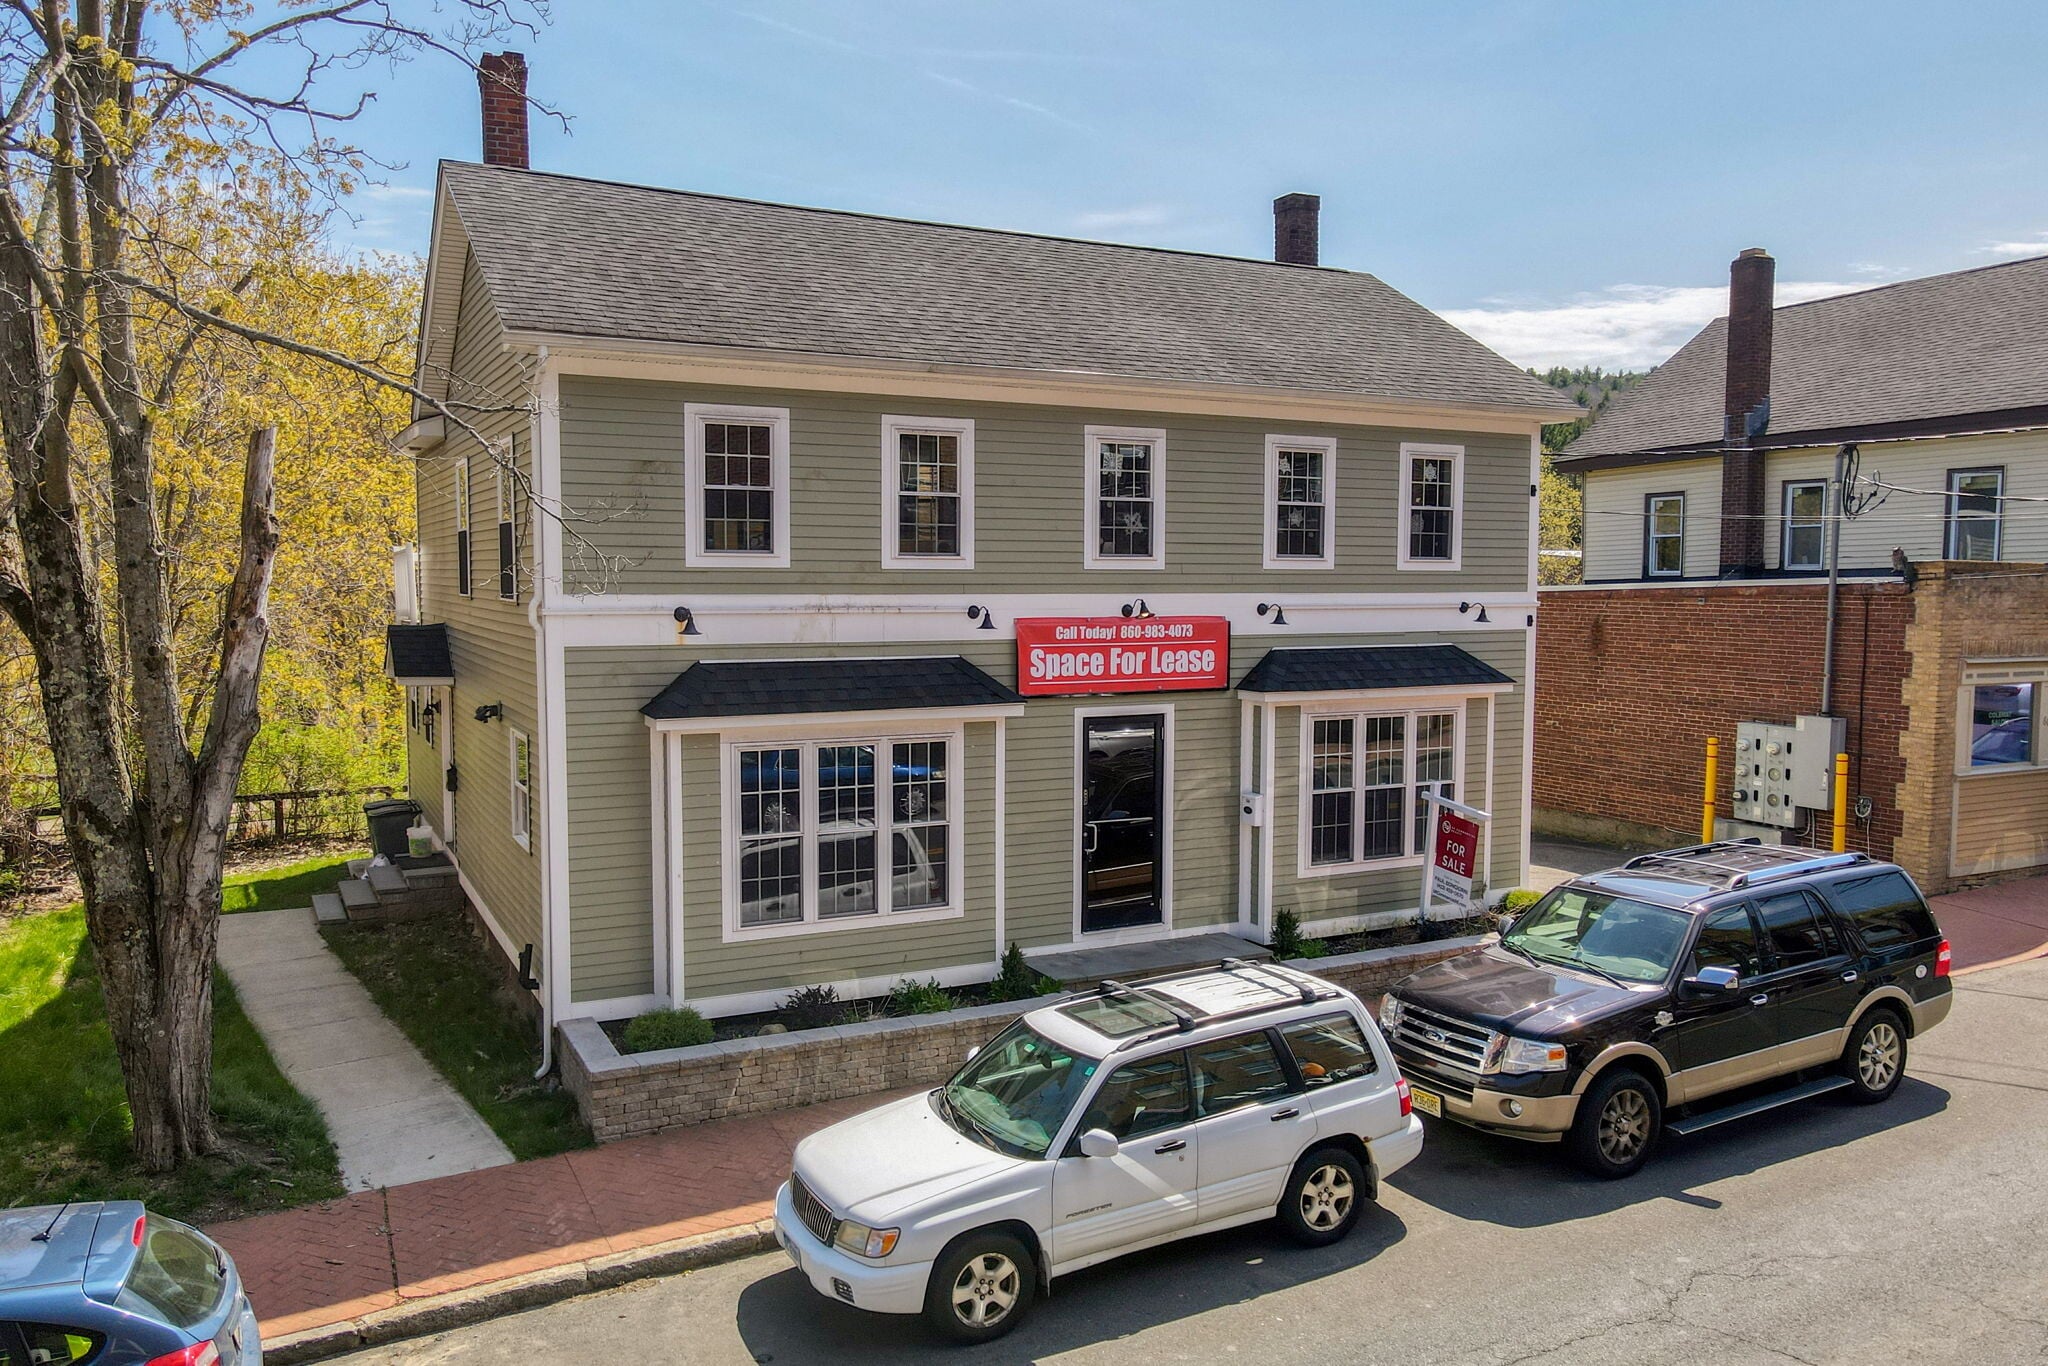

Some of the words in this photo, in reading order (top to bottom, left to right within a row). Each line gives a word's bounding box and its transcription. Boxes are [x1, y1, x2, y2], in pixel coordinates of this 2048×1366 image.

[1055, 626, 1077, 640] Call
[1080, 625, 1117, 640] Today!
[1120, 624, 1194, 639] 860-983-4073
[1030, 648, 1104, 680] Space
[1110, 647, 1147, 676] For
[1151, 647, 1216, 675] Lease
[1446, 840, 1466, 857] FOR
[1441, 855, 1466, 874] SALE
